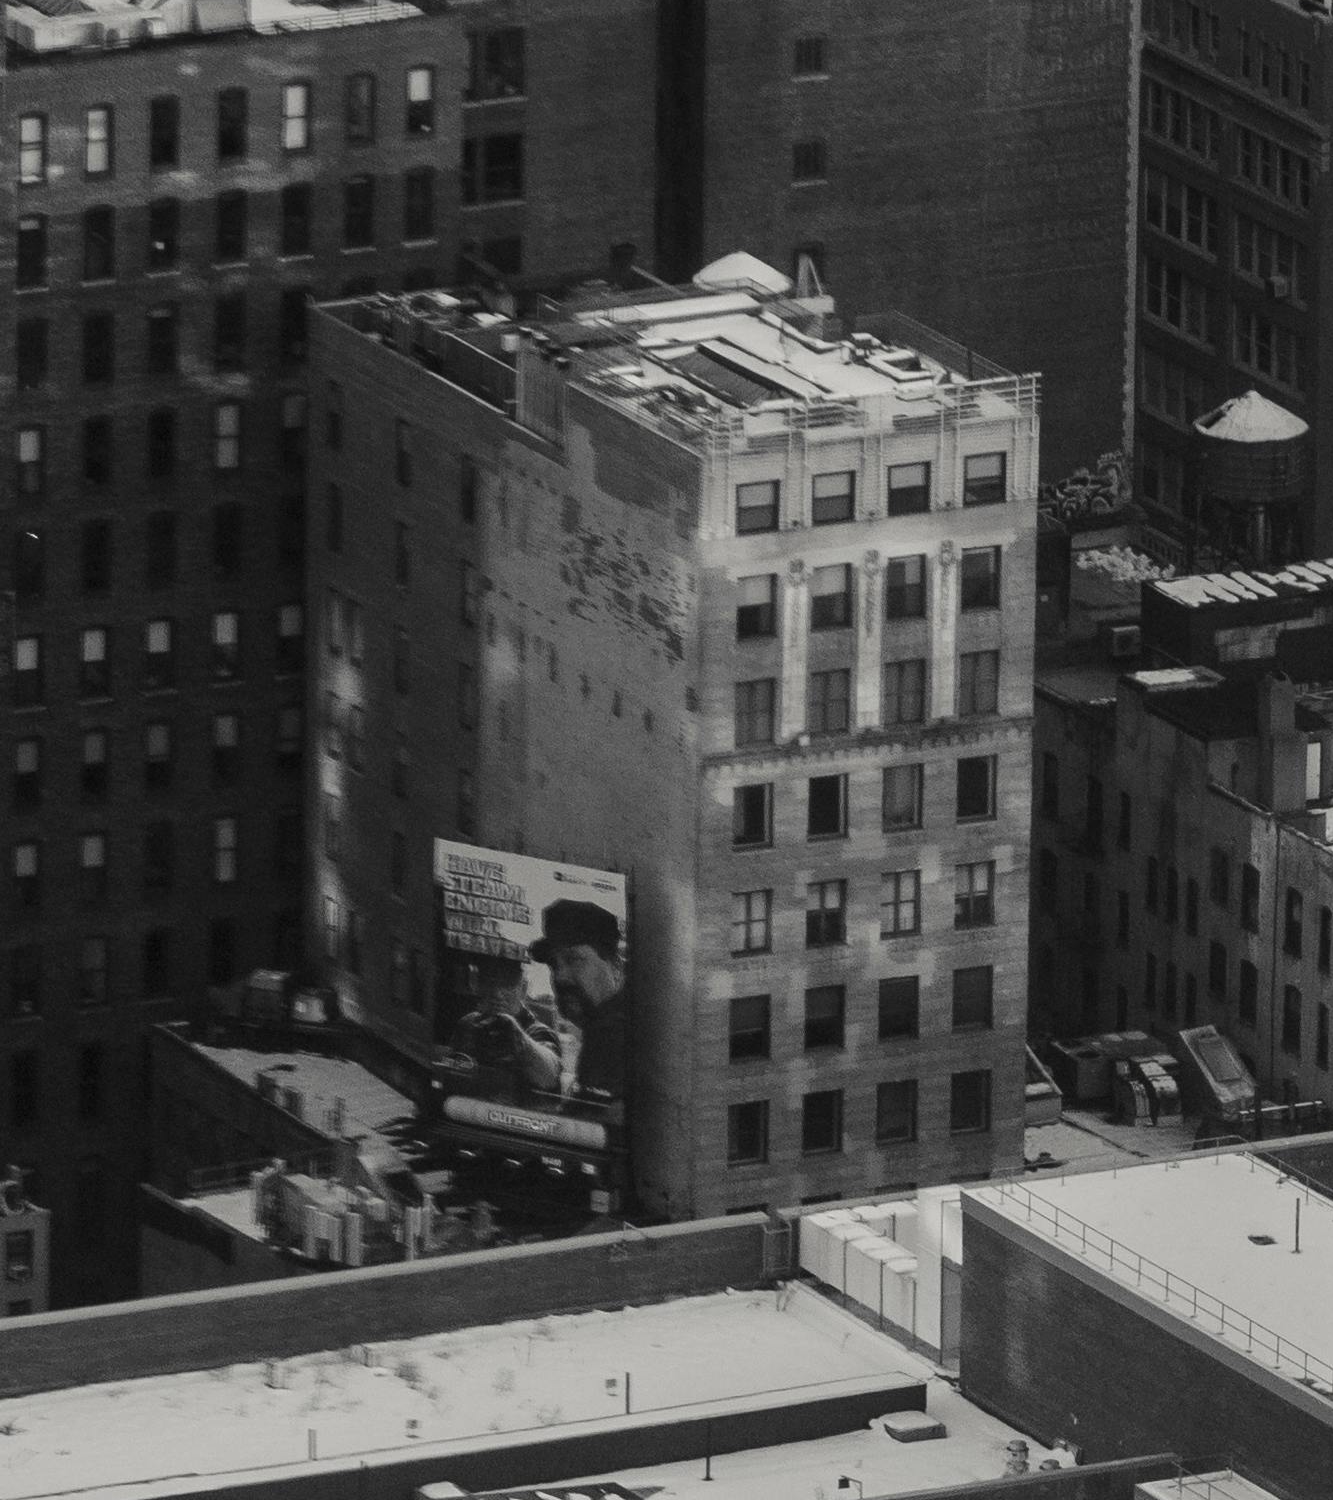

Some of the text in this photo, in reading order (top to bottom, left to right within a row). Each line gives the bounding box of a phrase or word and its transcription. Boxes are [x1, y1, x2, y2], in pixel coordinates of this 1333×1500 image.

[447, 854, 504, 881] HAVE
[443, 873, 527, 902] STEAM
[444, 891, 530, 924] ENGINE
[489, 1111, 556, 1135] OUTFRONT
